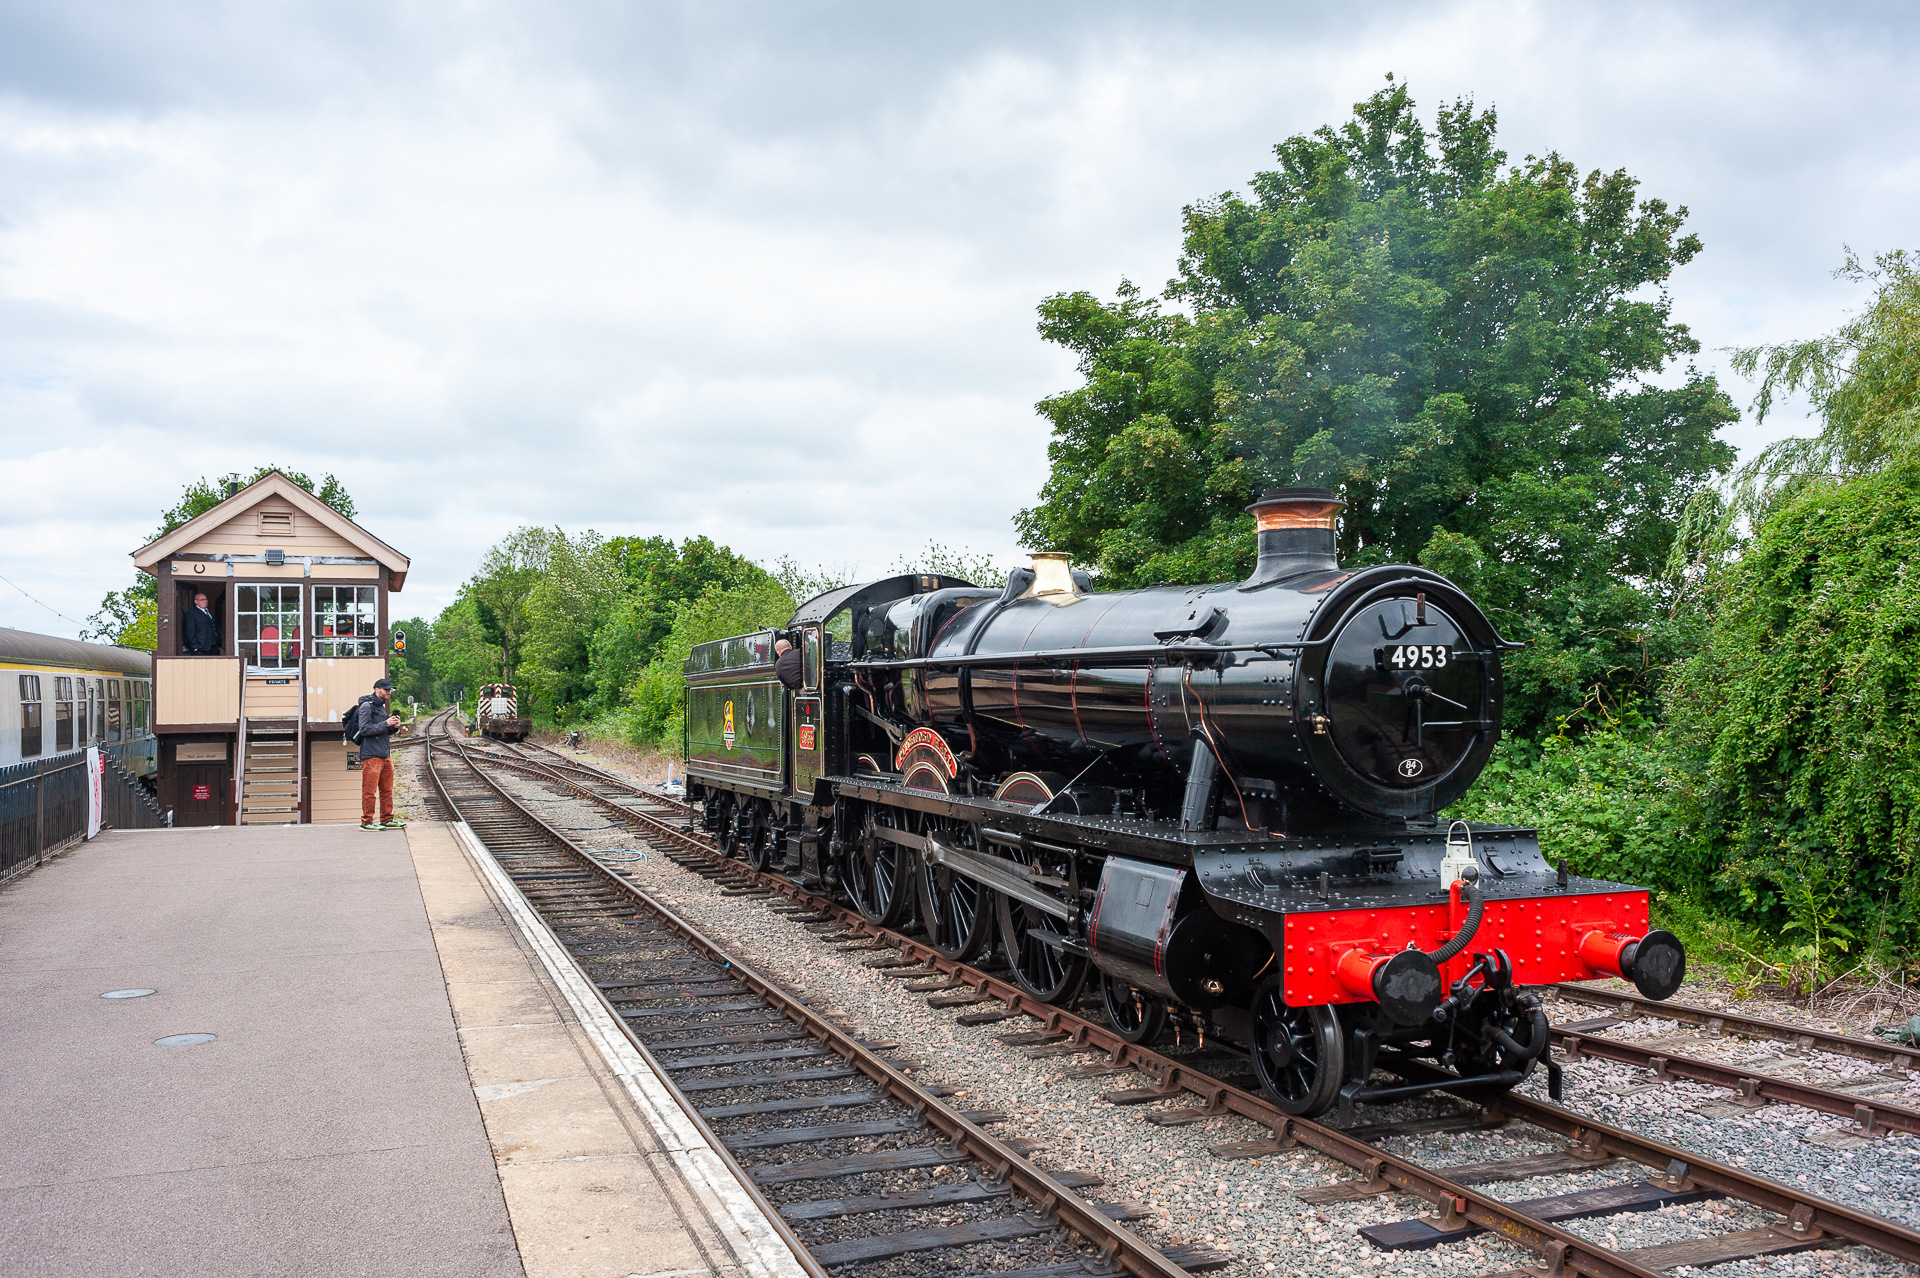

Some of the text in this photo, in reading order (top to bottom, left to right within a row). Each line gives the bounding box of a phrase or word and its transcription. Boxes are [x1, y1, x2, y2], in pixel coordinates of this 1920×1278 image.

[1391, 645, 1447, 668] 4953
[934, 736, 952, 769] HALL
[1405, 760, 1417, 769] 84
[1407, 768, 1413, 776] E
